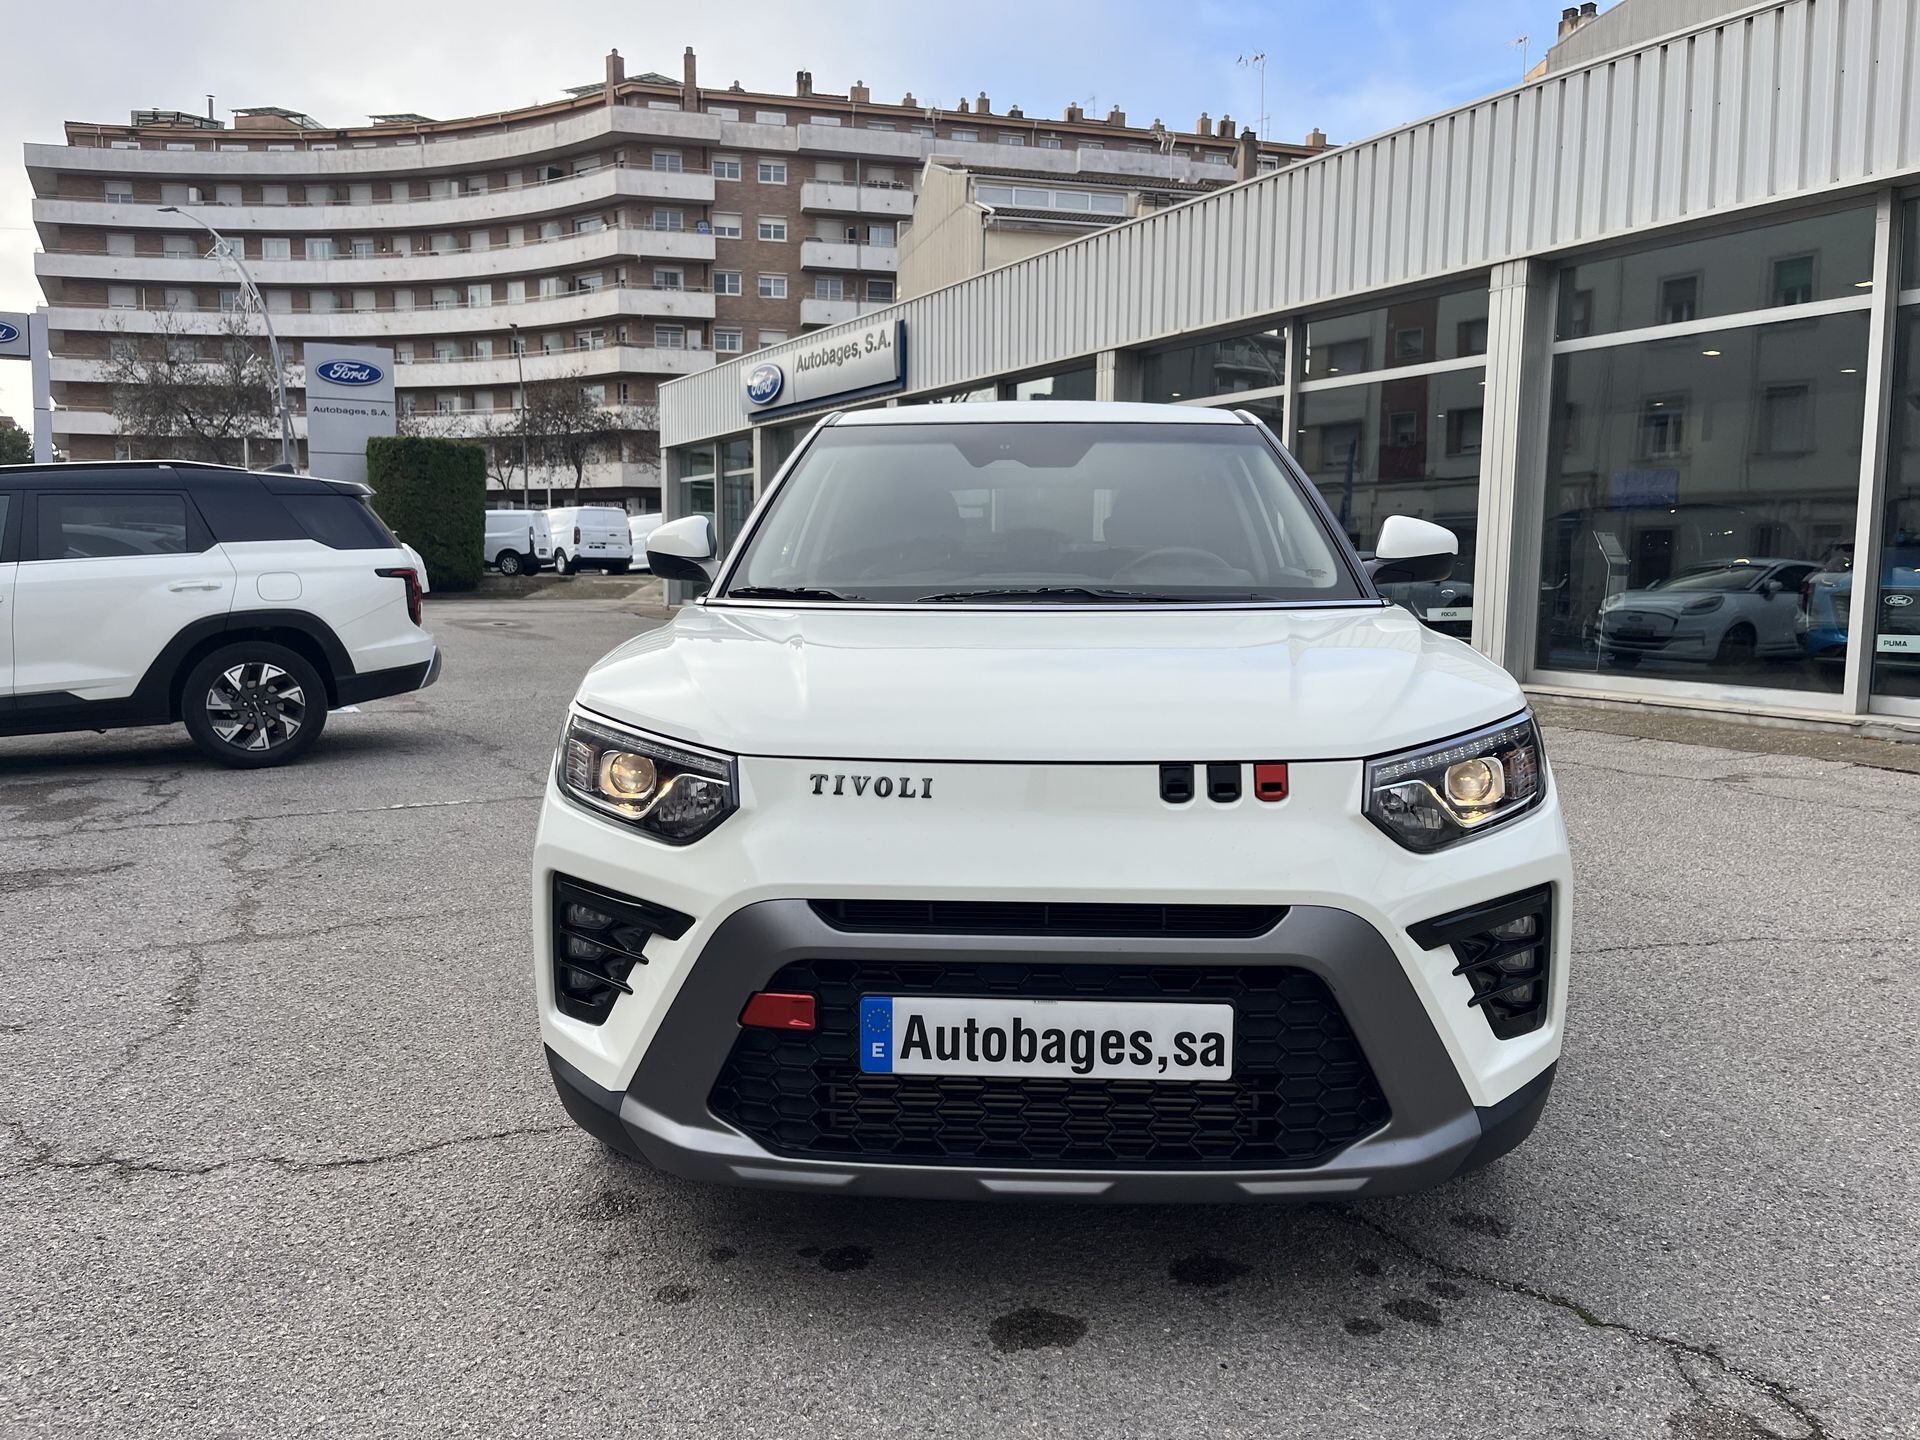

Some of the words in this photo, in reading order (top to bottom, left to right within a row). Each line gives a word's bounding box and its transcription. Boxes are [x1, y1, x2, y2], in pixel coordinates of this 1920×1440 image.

[796, 343, 862, 373] Autobages,
[865, 329, 891, 353] S.A.
[329, 363, 370, 380] Ford
[751, 371, 773, 396] Ford
[313, 406, 369, 416] Autobages,
[371, 408, 390, 416] S.A.
[809, 773, 933, 799] TIVOLI
[871, 1042, 885, 1058] E
[899, 1014, 1225, 1075] Autobages,sa
